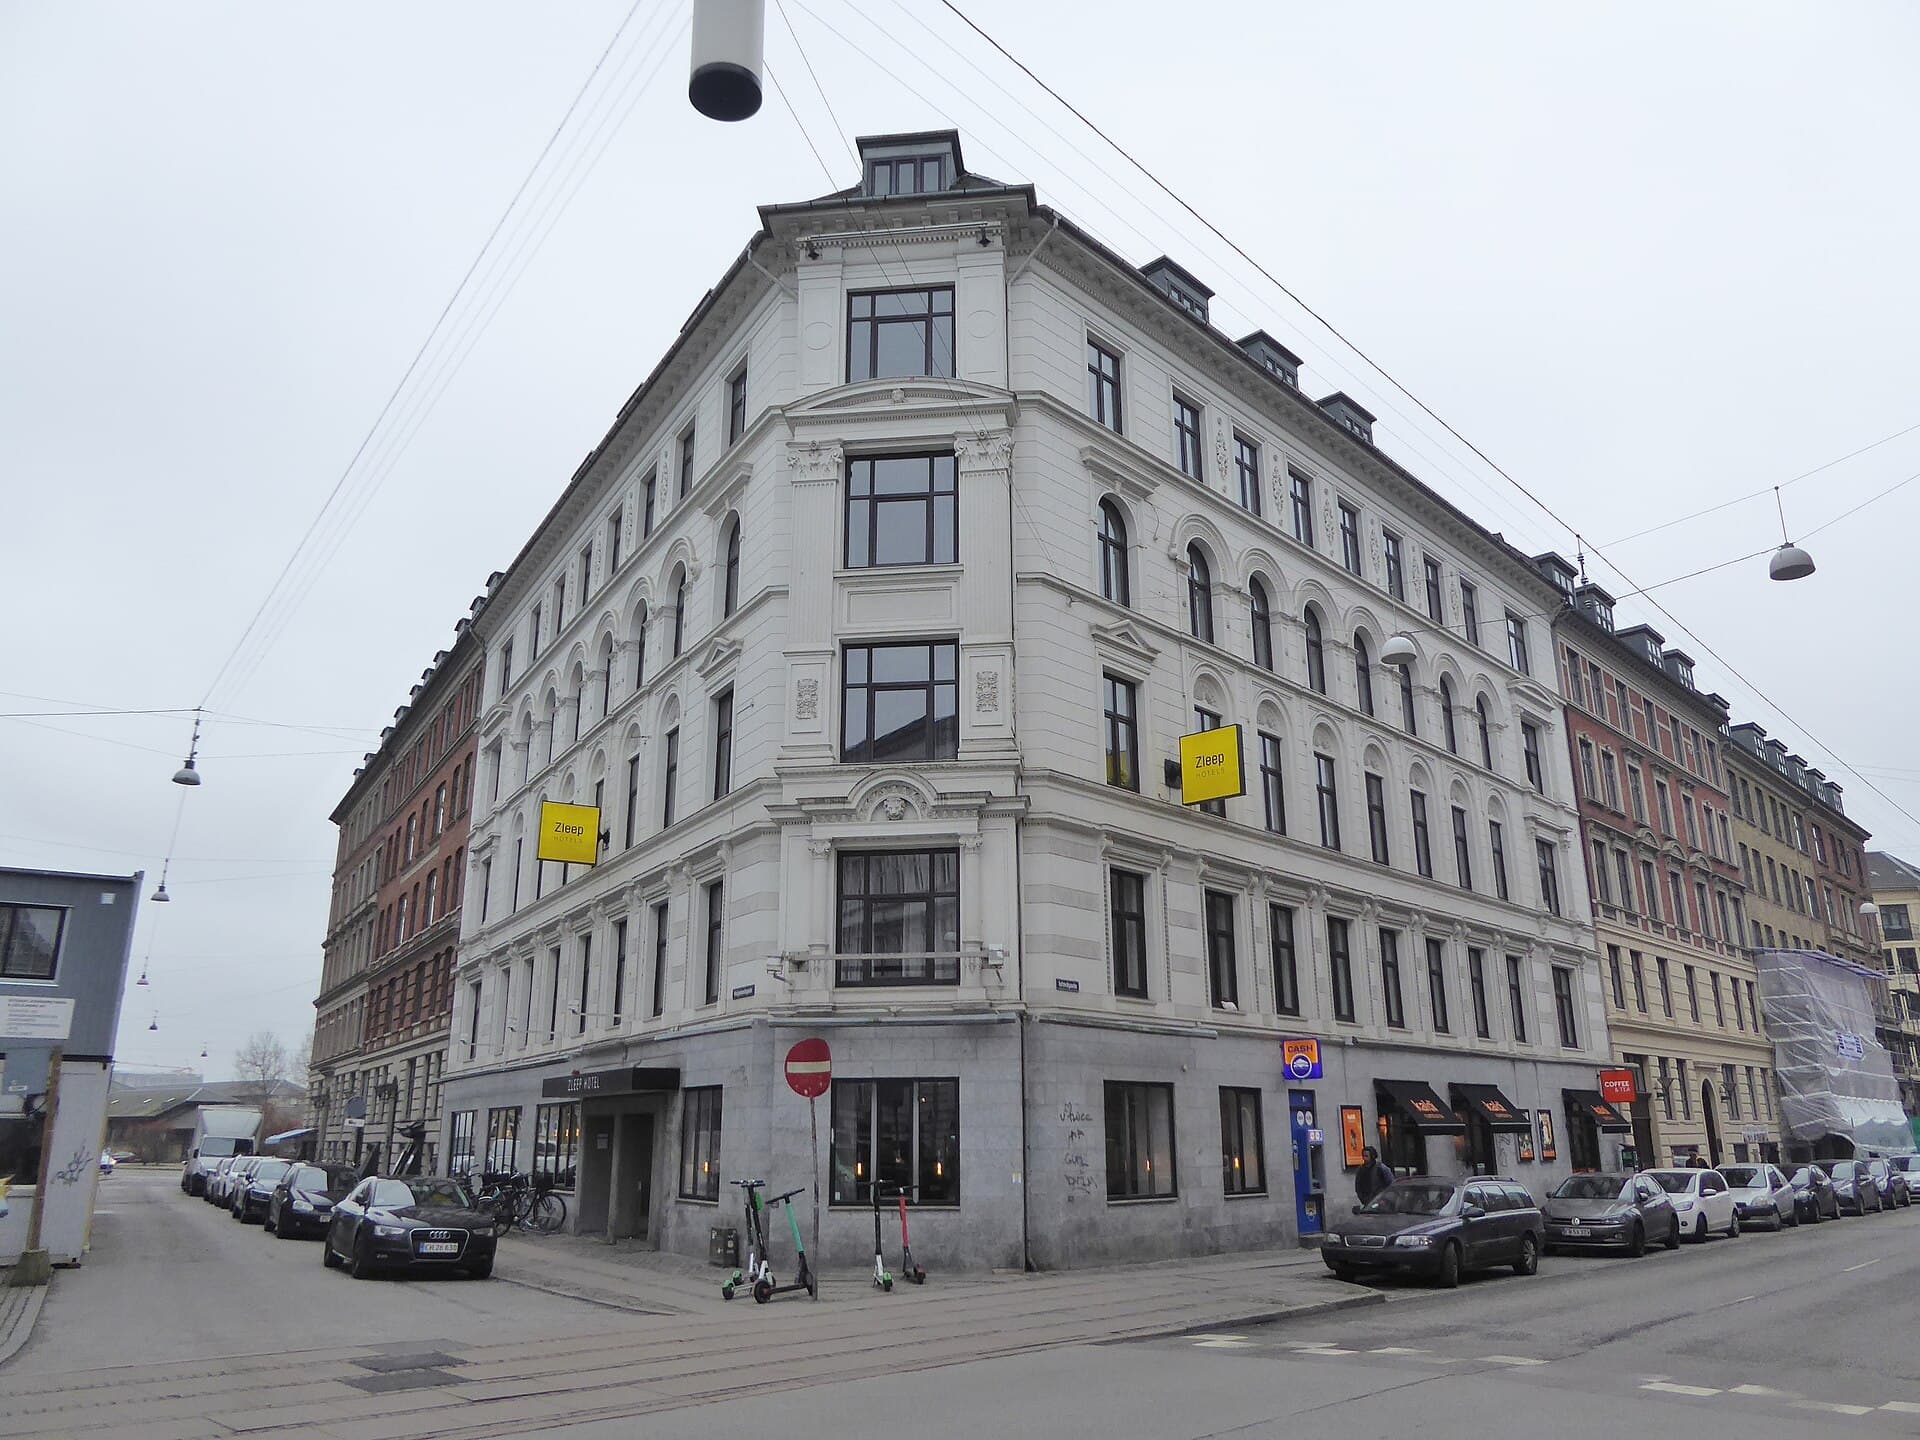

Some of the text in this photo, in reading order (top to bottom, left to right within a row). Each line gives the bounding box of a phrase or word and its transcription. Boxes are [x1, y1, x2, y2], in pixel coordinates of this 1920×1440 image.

[1195, 753, 1225, 768] Zleep
[554, 822, 584, 836] Zleep
[1287, 1044, 1313, 1053] CASH
[567, 1076, 600, 1092] ZLEEP HOTEL
[1604, 1080, 1630, 1088] COFFEE
